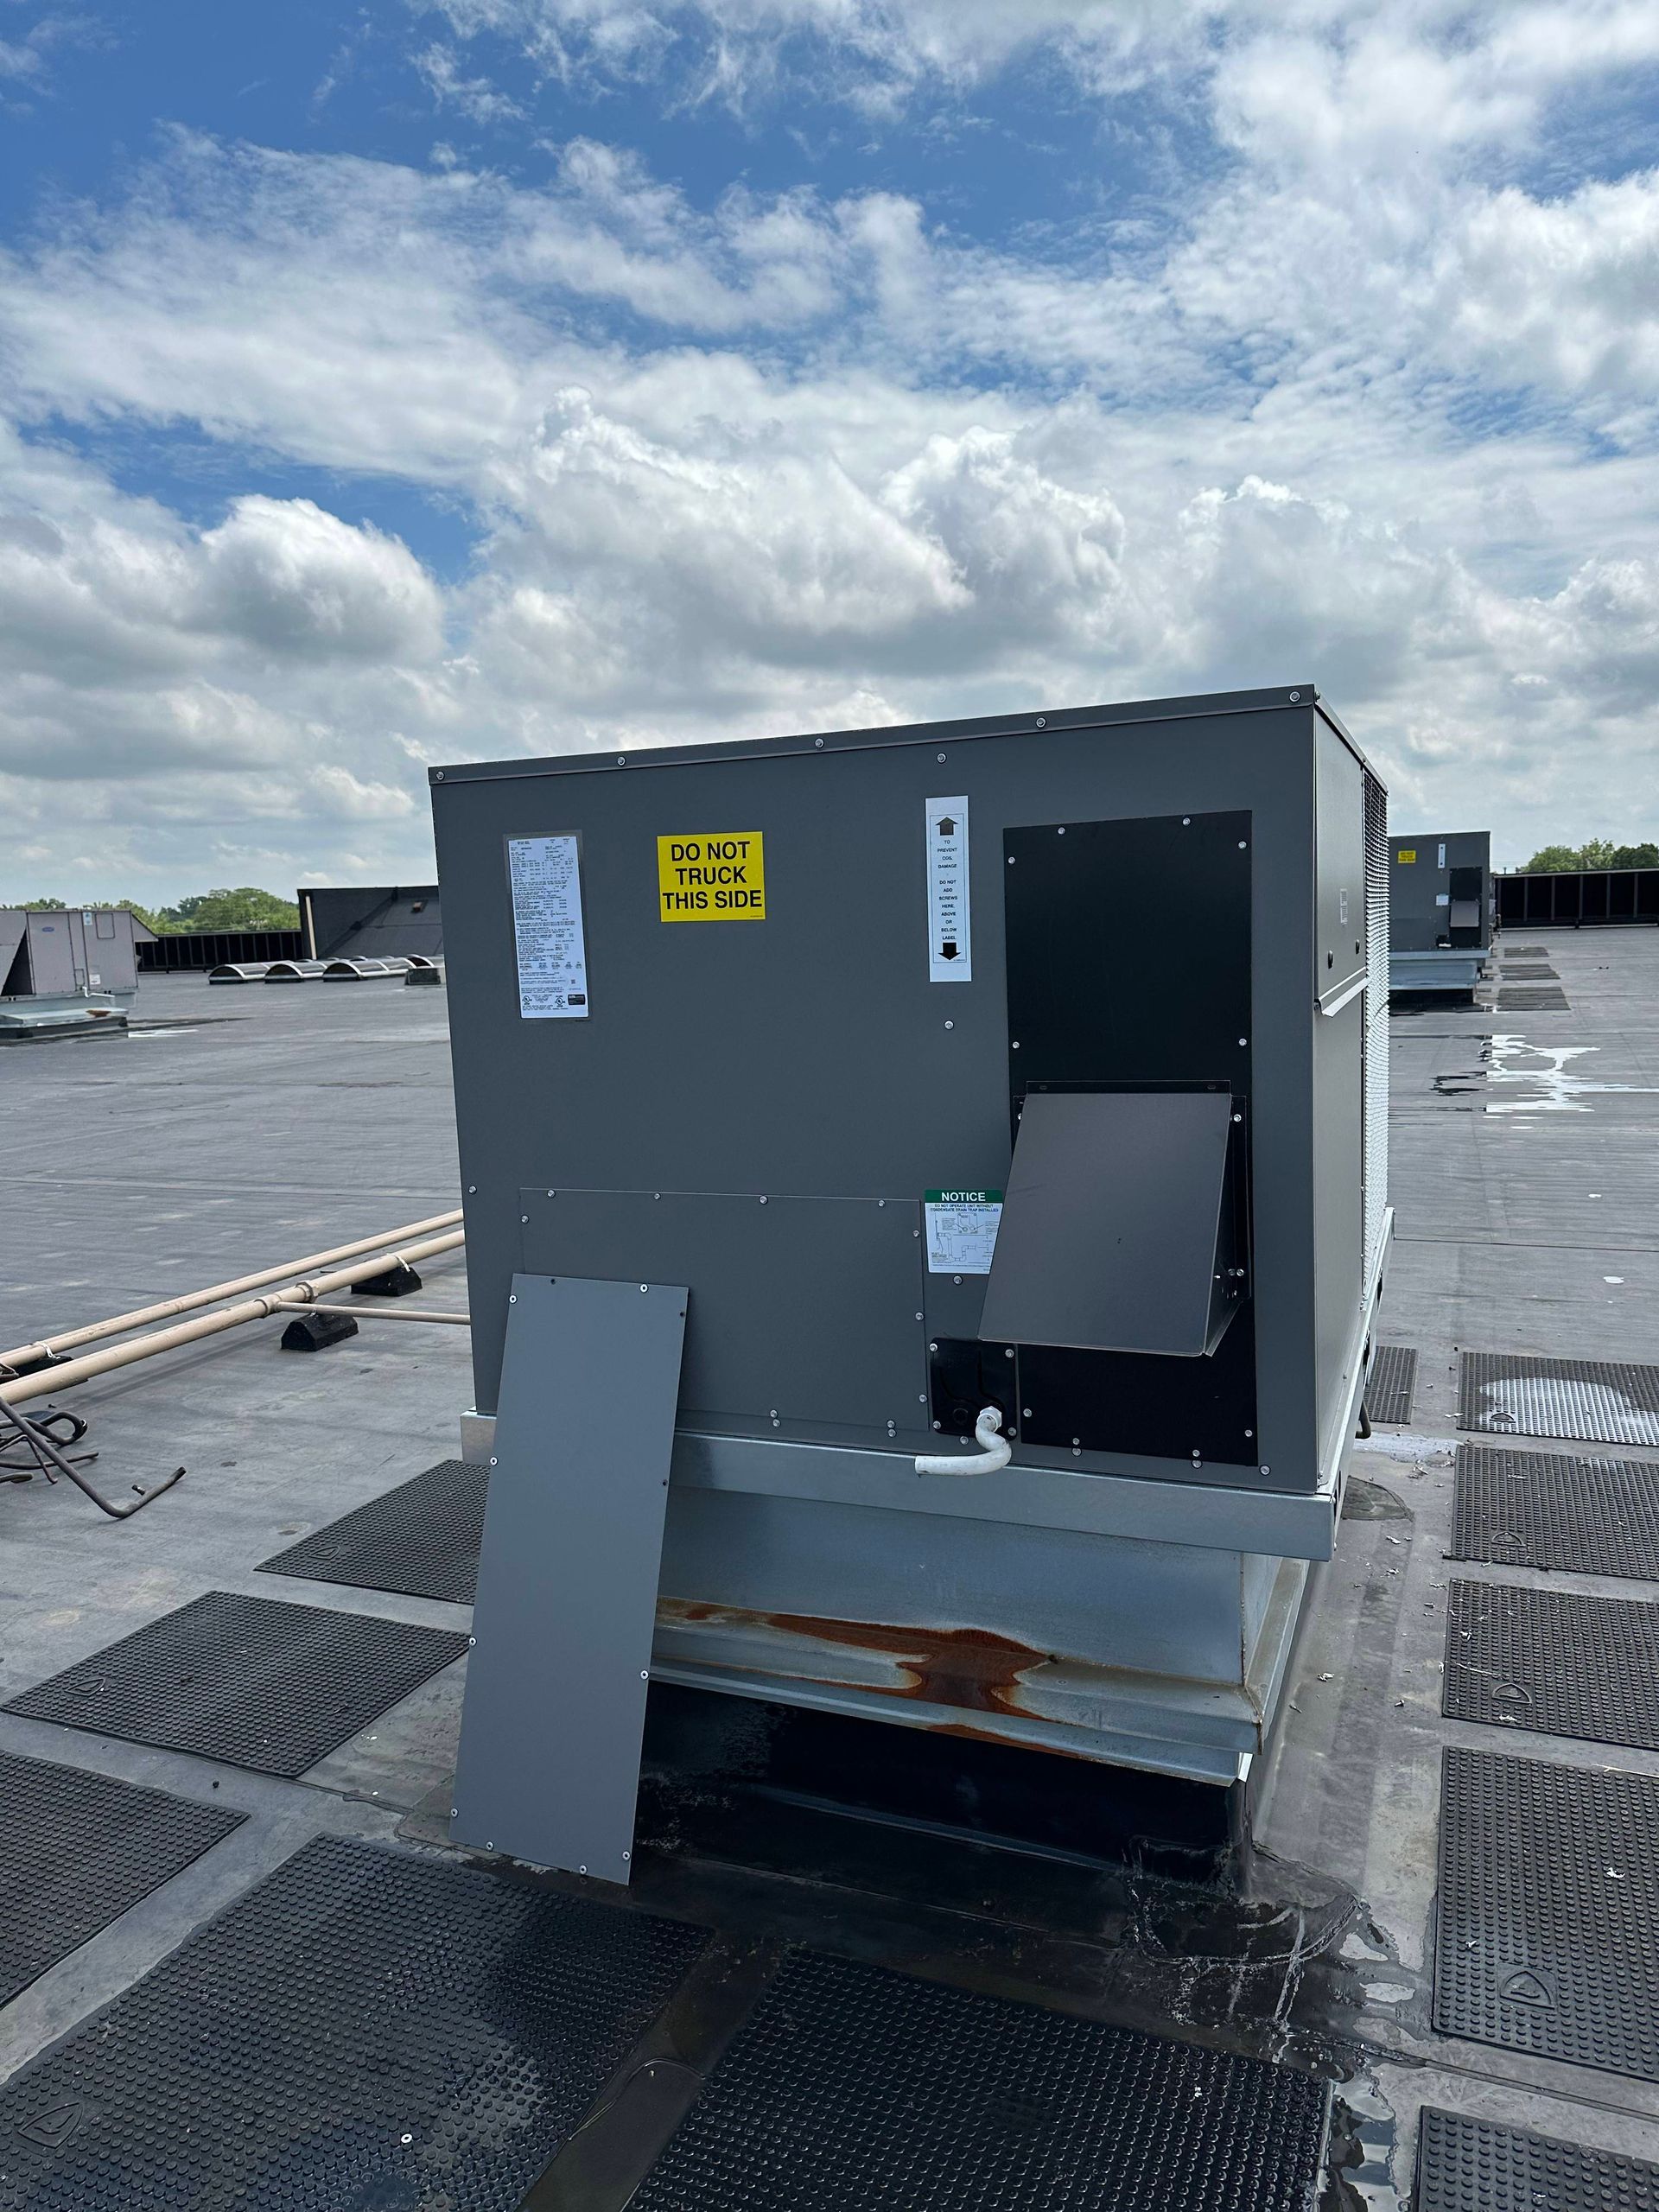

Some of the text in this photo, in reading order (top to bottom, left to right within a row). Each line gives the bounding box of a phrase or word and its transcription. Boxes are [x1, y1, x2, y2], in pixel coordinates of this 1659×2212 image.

[671, 841, 750, 861] DO NOT
[675, 866, 747, 886] TRUCK
[662, 890, 762, 910] THIS SIDE
[941, 1192, 986, 1202] NOTICE
